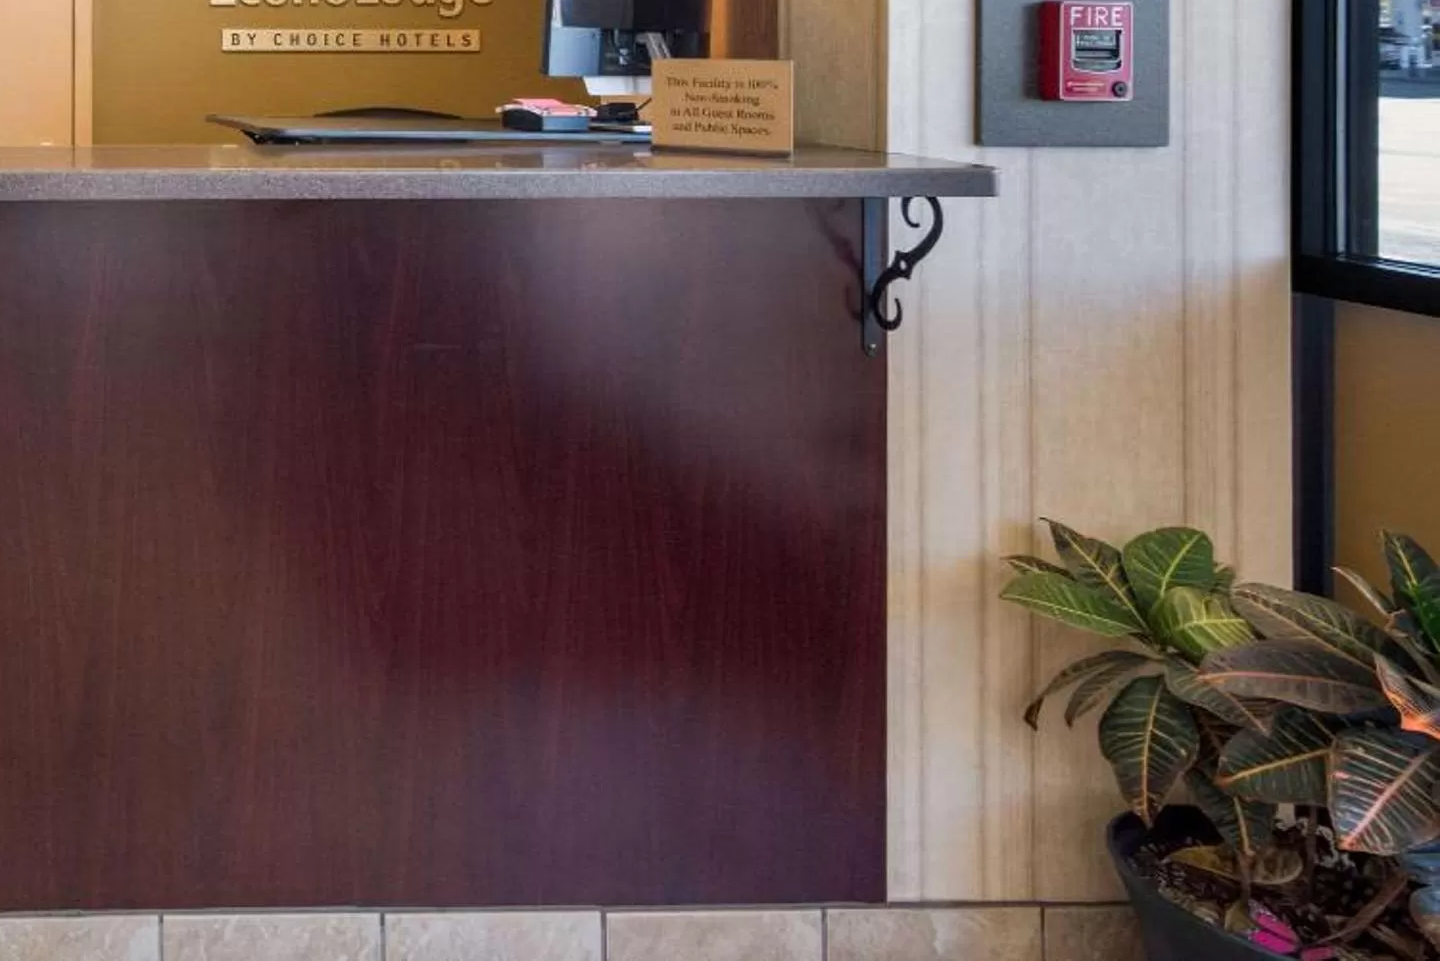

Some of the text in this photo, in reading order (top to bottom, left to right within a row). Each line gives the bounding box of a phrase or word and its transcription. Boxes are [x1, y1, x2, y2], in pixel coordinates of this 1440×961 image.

[1070, 6, 1123, 27] FIRE
[231, 33, 473, 47] BY CHOICE HOTELS
[666, 76, 689, 88] This
[692, 77, 732, 91] Facility
[682, 106, 700, 118] All
[701, 107, 734, 120] Guest
[736, 108, 776, 121] Rooms
